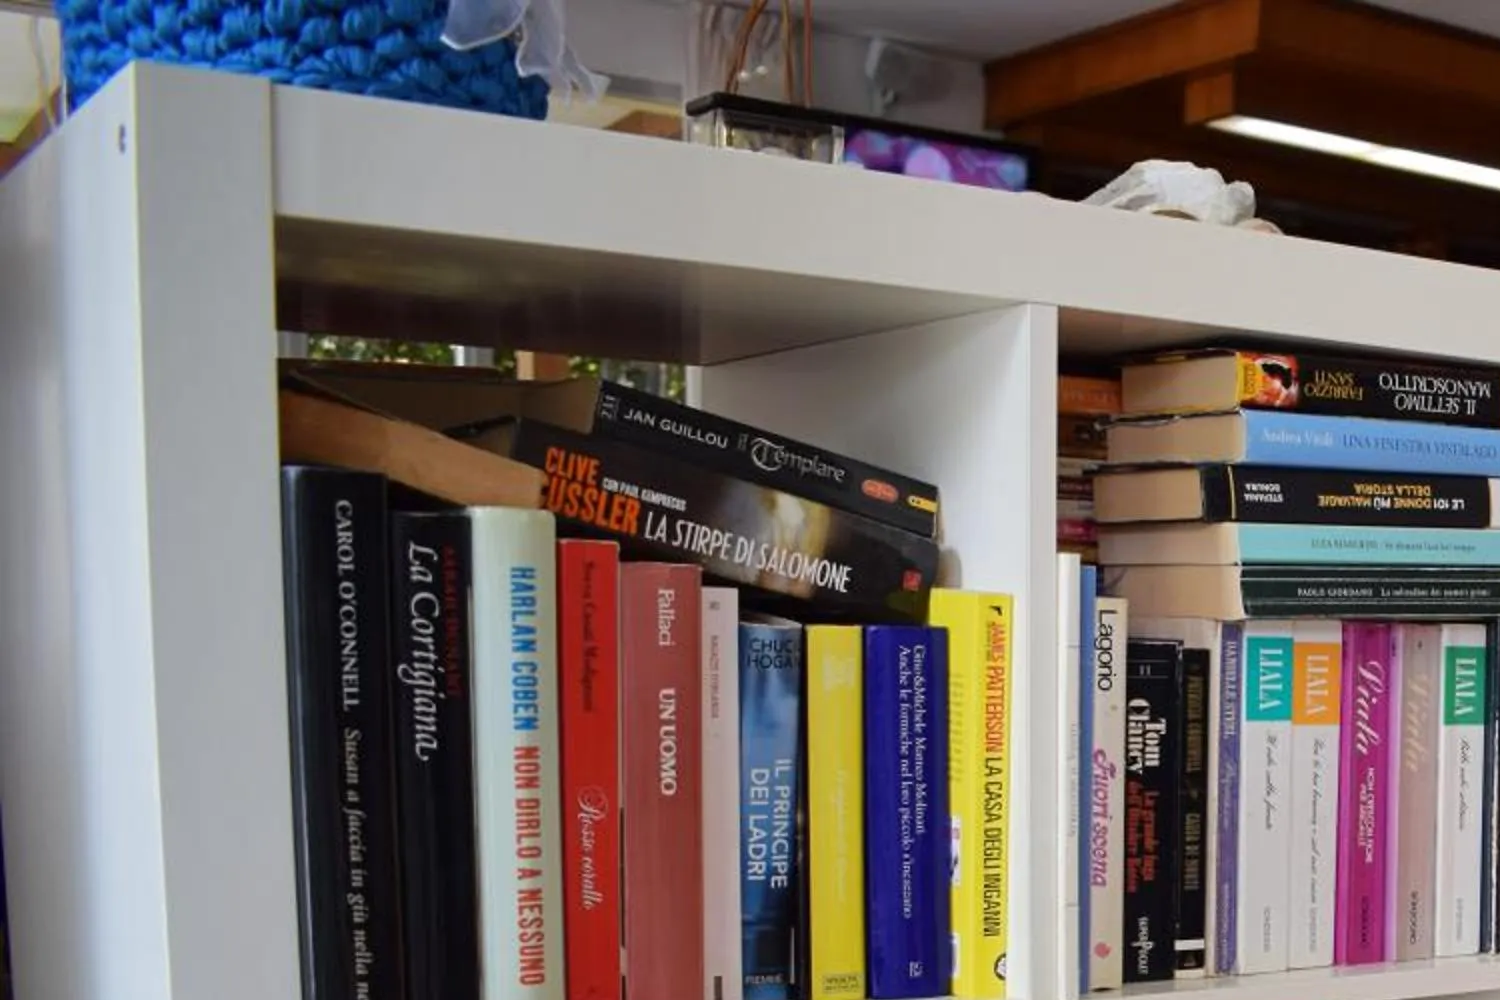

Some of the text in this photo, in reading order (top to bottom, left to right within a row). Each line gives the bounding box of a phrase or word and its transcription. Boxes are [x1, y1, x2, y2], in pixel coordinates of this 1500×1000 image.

[1304, 383, 1364, 401] FABRIZIO
[1379, 372, 1492, 398] MANOSCRITTO
[1394, 393, 1476, 415] IL SETTIMO
[623, 407, 730, 450] JAN GUILLOU
[545, 447, 600, 486] CLIVE
[750, 437, 847, 484] Templare
[540, 473, 641, 536] USSLER
[1434, 498, 1450, 510] 101
[335, 499, 355, 577] CAROL
[644, 511, 852, 593] LA STIRPE DI SALOMONE
[338, 580, 361, 712] O'CONNELL
[397, 540, 446, 761] La Cortigiana
[987, 621, 1007, 665] JAMES
[1094, 608, 1118, 692] Lagorio
[657, 588, 677, 796] Fallaci UN UOMO
[984, 666, 1007, 752] PATTERSON
[1258, 647, 1284, 711] LIALA
[1305, 654, 1330, 716] LIALA
[1356, 660, 1387, 756] Liala
[1454, 657, 1478, 717] LIALA
[344, 727, 362, 784] Susan
[1127, 698, 1151, 775] Clancy
[1144, 718, 1167, 767] Tom
[510, 566, 546, 987] HARLAN COBEN NON DIRLO A NESSUNO
[983, 757, 1004, 777] LA
[747, 768, 770, 882] DEI LADRI
[770, 758, 793, 889] IL PRINCIPE
[983, 780, 1004, 823] CASA
[342, 805, 367, 862] faccia
[983, 827, 1003, 869] DEGLI
[1090, 822, 1112, 887] scena
[350, 868, 368, 888] in
[352, 928, 373, 976] nella
